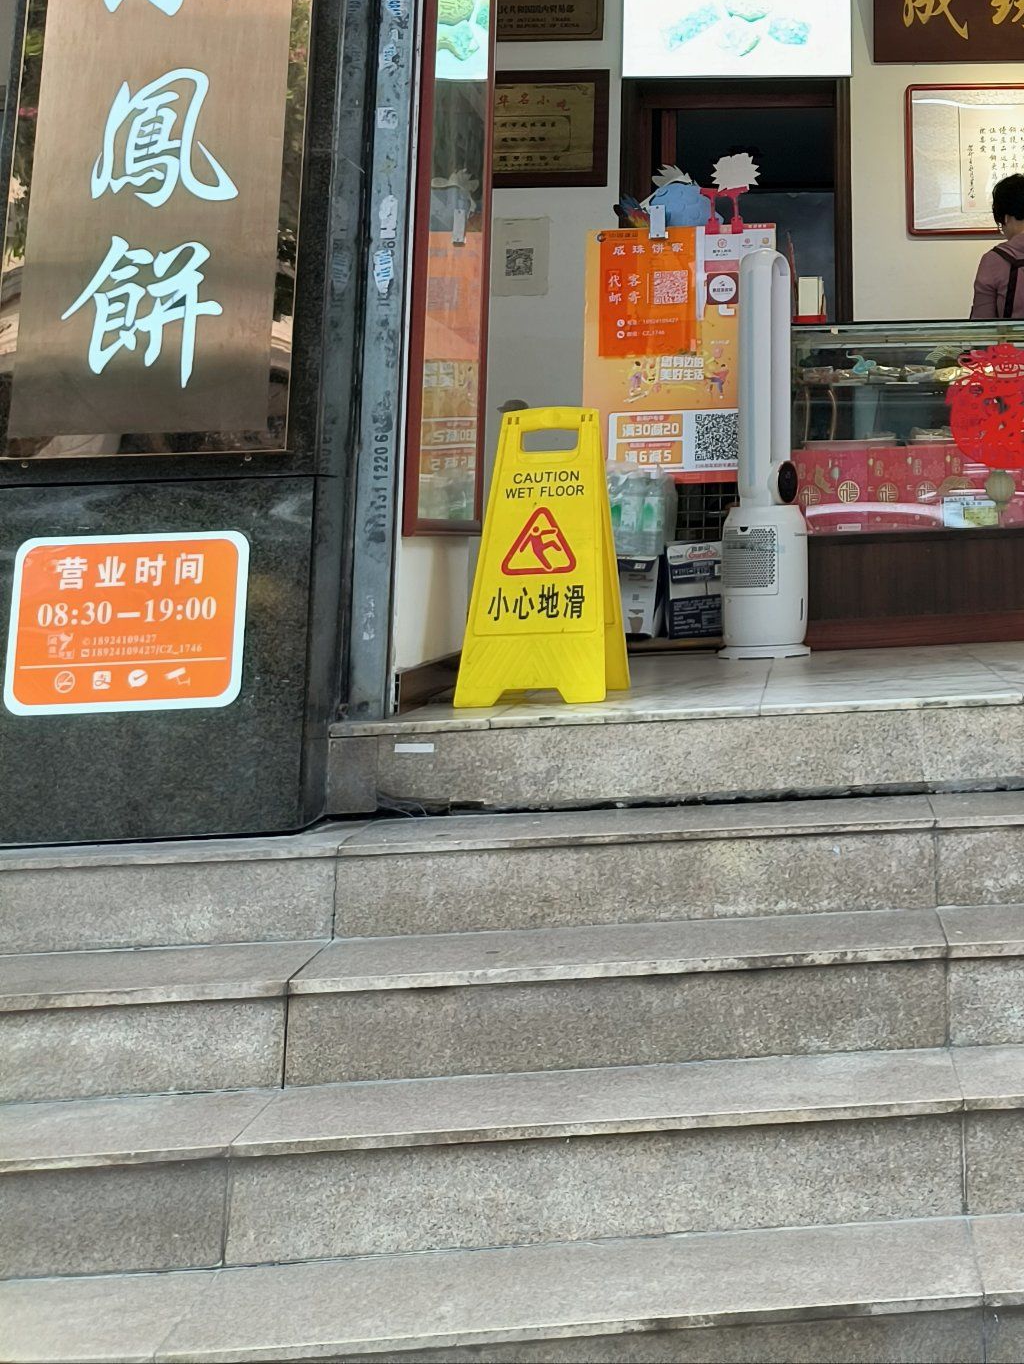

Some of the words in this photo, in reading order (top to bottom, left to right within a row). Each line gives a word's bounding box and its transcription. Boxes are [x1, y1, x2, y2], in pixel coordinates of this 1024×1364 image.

[608, 274, 642, 288] 代客
[608, 291, 642, 305] 邮寄
[513, 470, 580, 485] CAUTION
[506, 487, 534, 499] WET
[540, 485, 585, 497] FLOOR
[55, 552, 205, 591] 营业时间
[487, 583, 585, 622] 小心地滑
